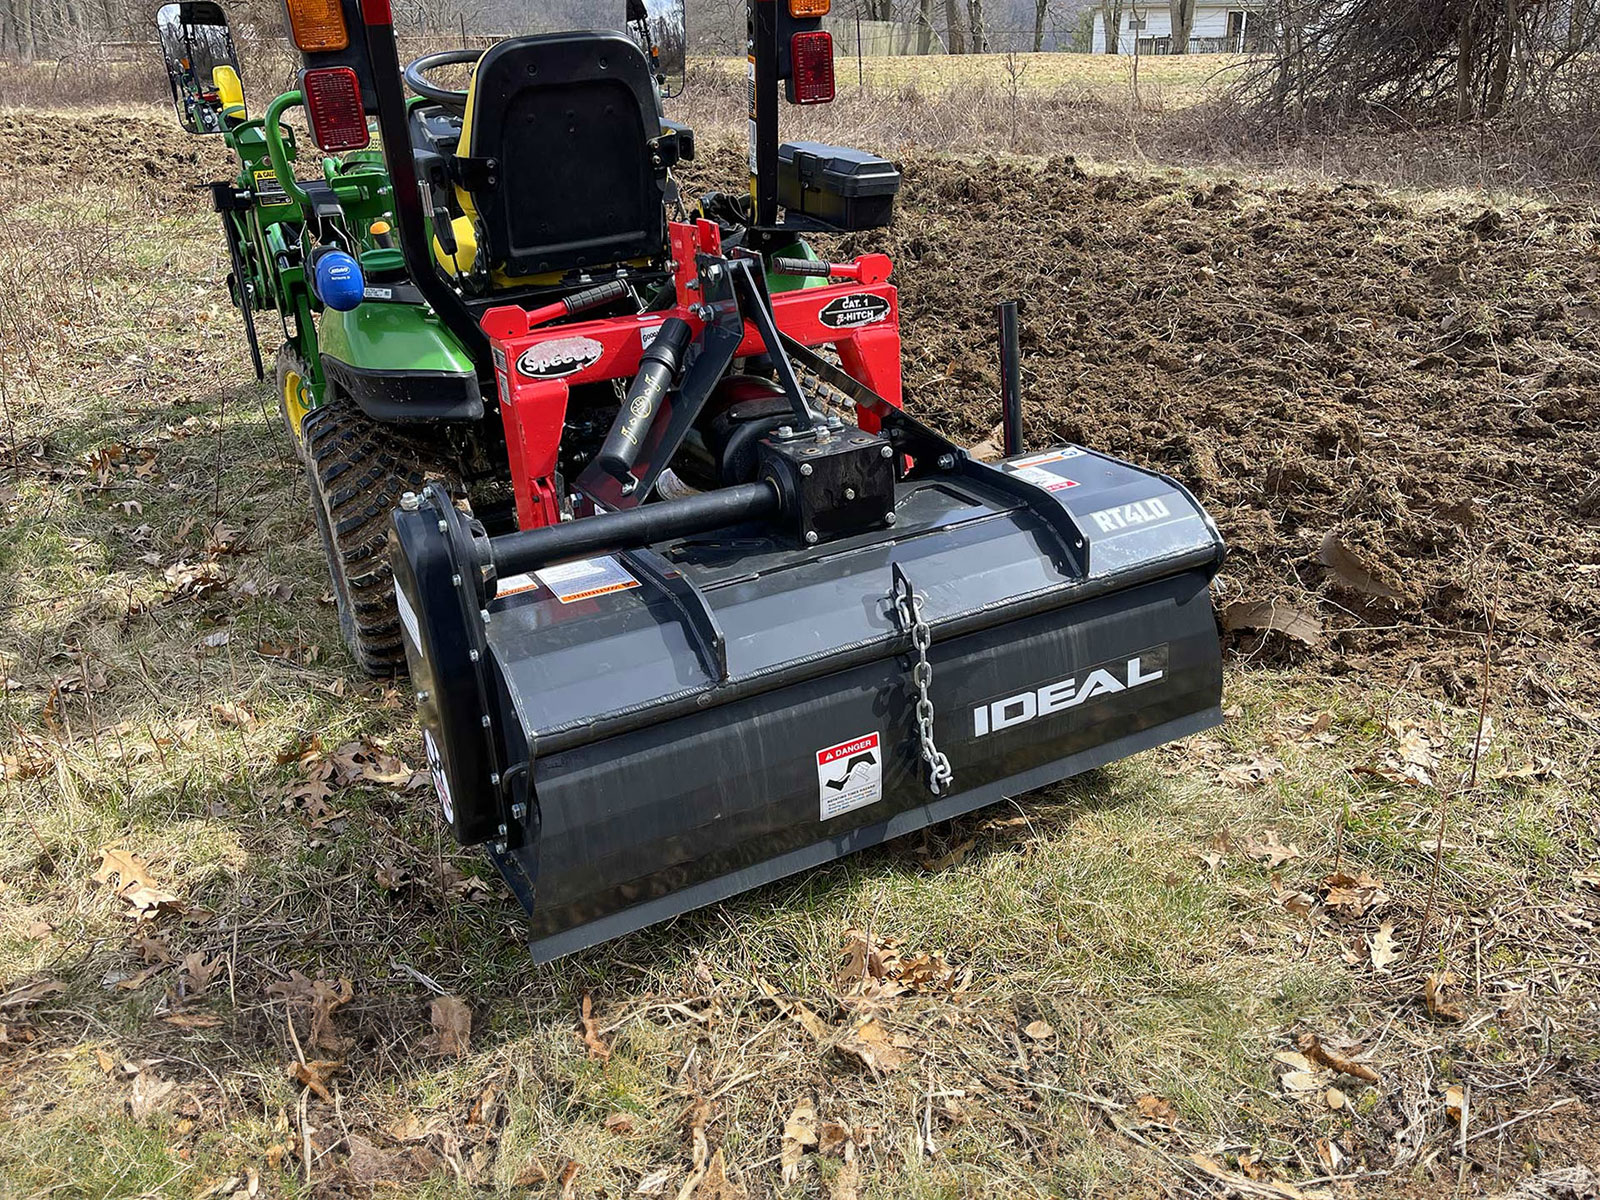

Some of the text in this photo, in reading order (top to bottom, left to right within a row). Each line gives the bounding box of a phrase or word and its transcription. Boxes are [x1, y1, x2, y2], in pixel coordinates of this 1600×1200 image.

[842, 298, 869, 309] CAT. 1
[973, 657, 1163, 738] IDEAL
[835, 740, 872, 757] DANGER
